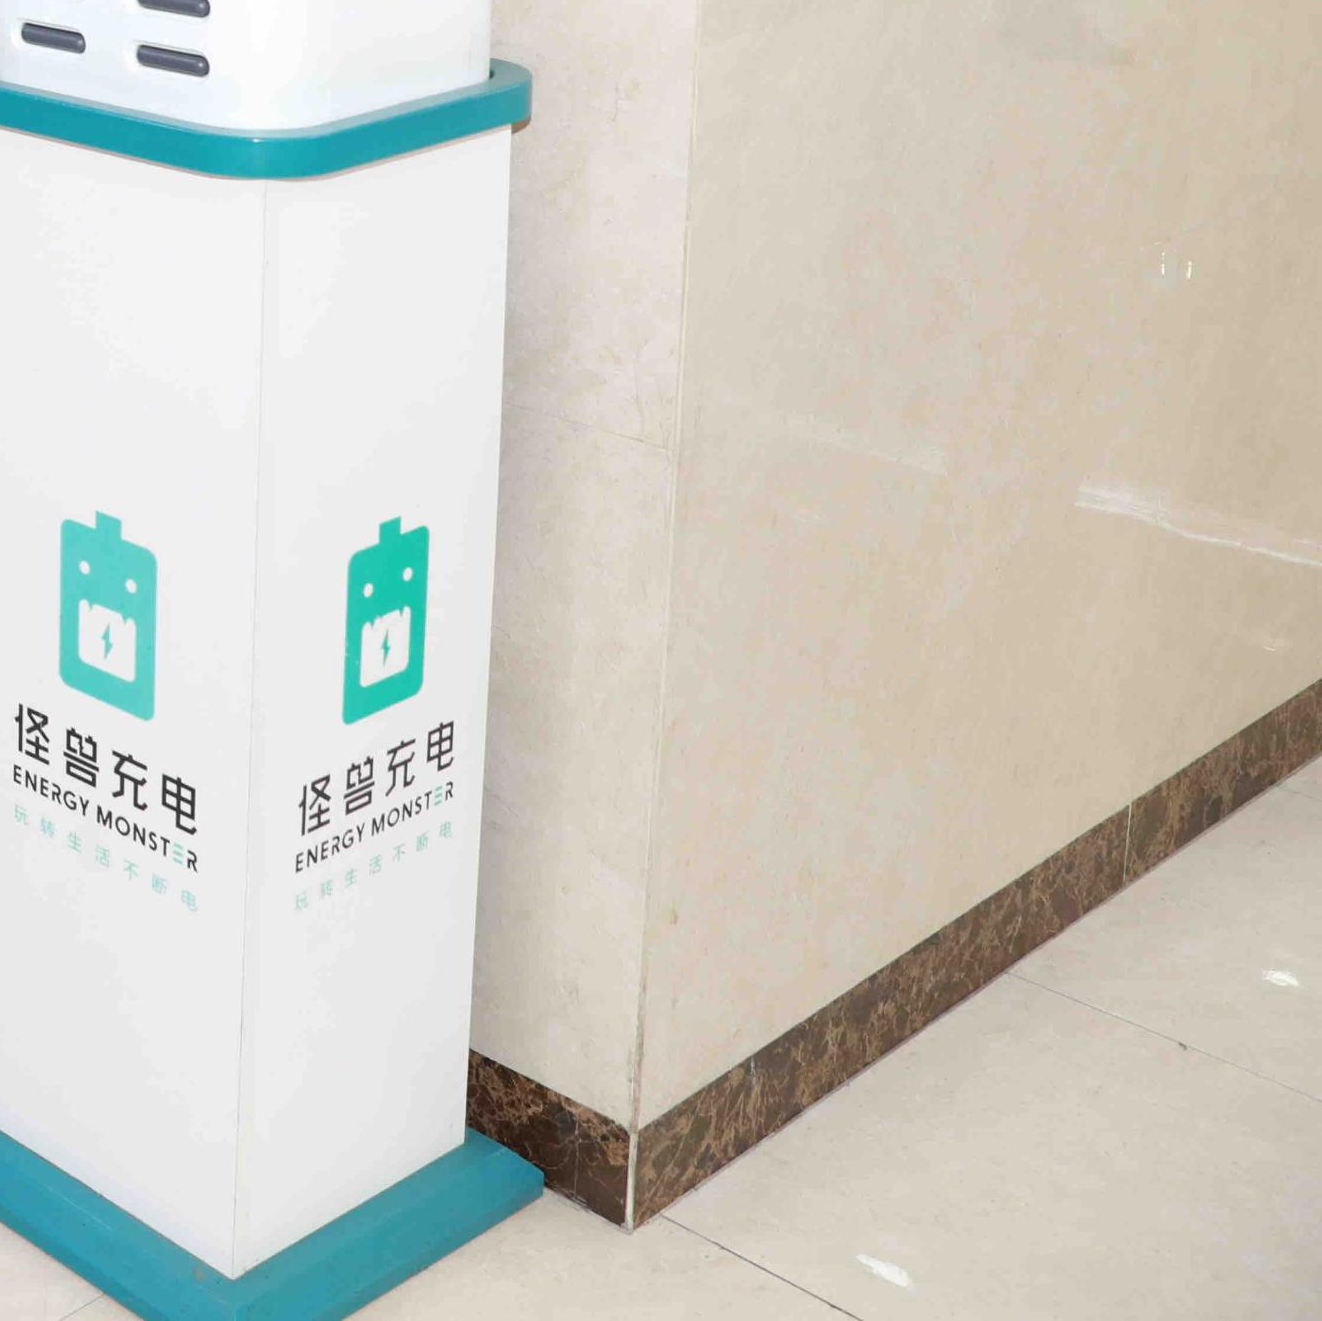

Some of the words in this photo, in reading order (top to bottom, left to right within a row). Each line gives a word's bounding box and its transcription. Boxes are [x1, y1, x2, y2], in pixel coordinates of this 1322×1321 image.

[13, 764, 90, 816] ENERGY
[97, 805, 198, 873] MONSTER
[15, 703, 197, 836] 怪兽充电
[298, 721, 454, 836] 怪兽充电
[14, 804, 198, 912] 玩转生活不断电
[294, 821, 452, 911] 玩转生活不断电
[296, 822, 366, 873] ENERGY
[371, 781, 454, 837] MONSTER
